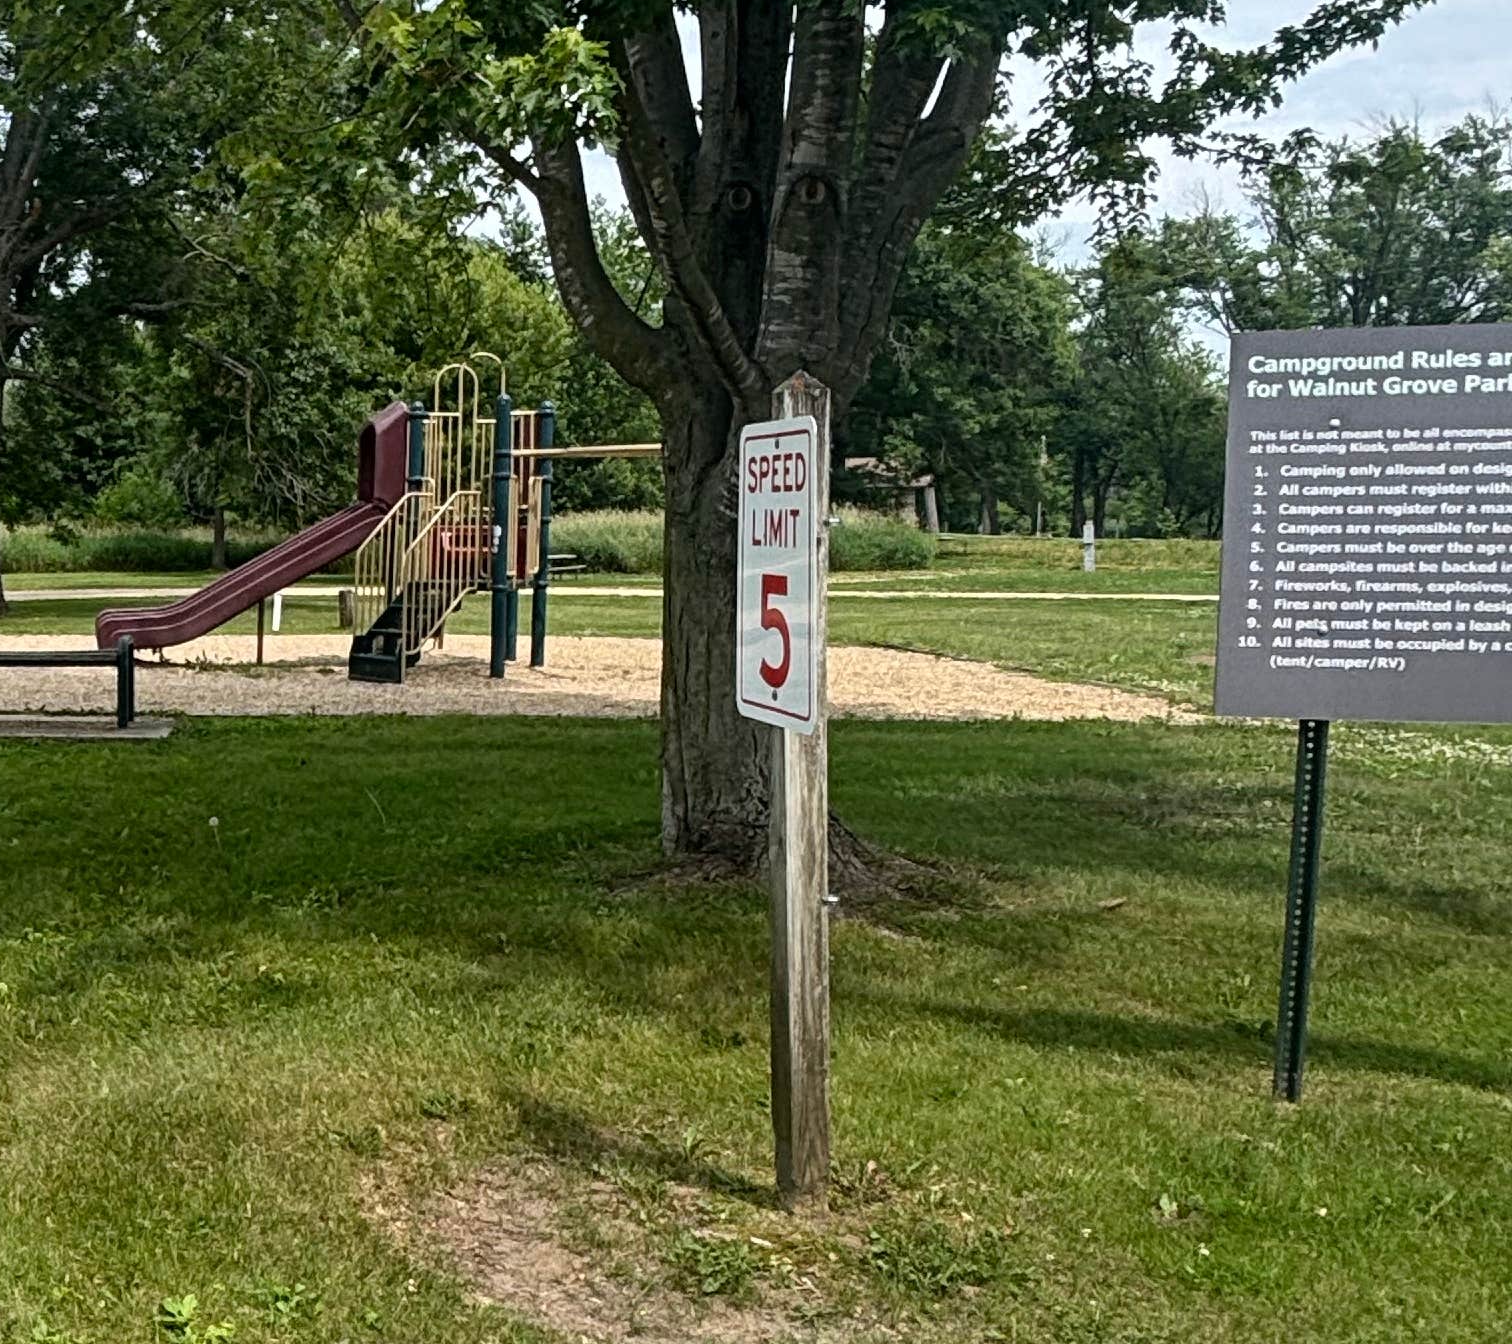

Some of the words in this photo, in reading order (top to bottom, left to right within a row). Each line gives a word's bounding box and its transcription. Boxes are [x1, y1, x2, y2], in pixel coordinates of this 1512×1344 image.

[1248, 351, 1404, 375] Campground
[1412, 349, 1481, 368] Rules
[1247, 380, 1282, 398] for
[1288, 378, 1377, 397] Walnut
[1383, 377, 1457, 395] Grove
[1251, 431, 1276, 441] This
[1279, 430, 1299, 440] list
[1302, 430, 1314, 440] is
[1316, 429, 1338, 440] not
[1341, 429, 1383, 439] meant
[1386, 429, 1400, 439] to
[1403, 428, 1420, 438] be
[1248, 444, 1263, 454] at
[1266, 443, 1287, 454] the
[1290, 443, 1346, 455] Camping
[1437, 442, 1451, 451] at
[748, 452, 806, 493] SPEED
[1254, 467, 1269, 478] 1.
[1280, 465, 1346, 479] Camping
[1349, 464, 1382, 478] only
[1385, 464, 1445, 475] allowed
[1449, 465, 1469, 475] on
[1254, 486, 1268, 496] 2.
[1279, 484, 1299, 495] All
[1302, 485, 1366, 498] campers
[1369, 484, 1408, 495] must
[1411, 484, 1472, 497] register
[1252, 504, 1267, 515] 3.
[1278, 504, 1343, 517] Campers
[1346, 505, 1374, 515] can
[1378, 503, 1437, 516] register
[1441, 503, 1463, 514] for
[1467, 505, 1477, 514] a
[752, 509, 800, 548] LIMIT
[1251, 523, 1266, 534] 4.
[1277, 523, 1342, 536] Campers
[1346, 524, 1371, 534] are
[1374, 522, 1461, 536] responsible
[1465, 522, 1489, 534] for
[1250, 543, 1264, 553] 5.
[1276, 543, 1342, 555] Campers
[1345, 542, 1383, 554] must
[1386, 542, 1406, 554] be
[1409, 543, 1444, 554] over
[1447, 542, 1473, 554] the
[1477, 544, 1506, 556] age
[1249, 561, 1264, 572] 6.
[1275, 561, 1295, 572] All
[1298, 561, 1374, 575] campsites
[1377, 561, 1415, 573] must
[1419, 561, 1438, 573] be
[1441, 561, 1497, 573] backed
[1248, 580, 1263, 591] 7.
[1274, 580, 1352, 593] Fireworks,
[1355, 580, 1423, 593] firearms,
[1273, 599, 1310, 610] Fires
[1312, 600, 1338, 611] are
[1341, 599, 1374, 613] only
[1376, 599, 1451, 613] permitted
[1455, 600, 1470, 611] in
[759, 574, 792, 689] 5
[1246, 618, 1261, 629] 9.
[1272, 618, 1292, 629] All
[1295, 619, 1327, 632] pets
[1331, 619, 1370, 630] must
[1372, 618, 1392, 630] be
[1395, 619, 1429, 633] kept
[1432, 621, 1452, 631] on
[1456, 621, 1466, 631] a
[1469, 619, 1511, 631] leash
[1238, 637, 1261, 647] 10.
[1272, 637, 1292, 648] All
[1295, 637, 1330, 648] sites
[1333, 638, 1371, 649] must
[1375, 638, 1394, 650] be
[1397, 638, 1464, 652] occupied
[1469, 638, 1488, 653] by
[1491, 642, 1501, 651] a
[1270, 655, 1406, 671] (tent/camper/RV)
